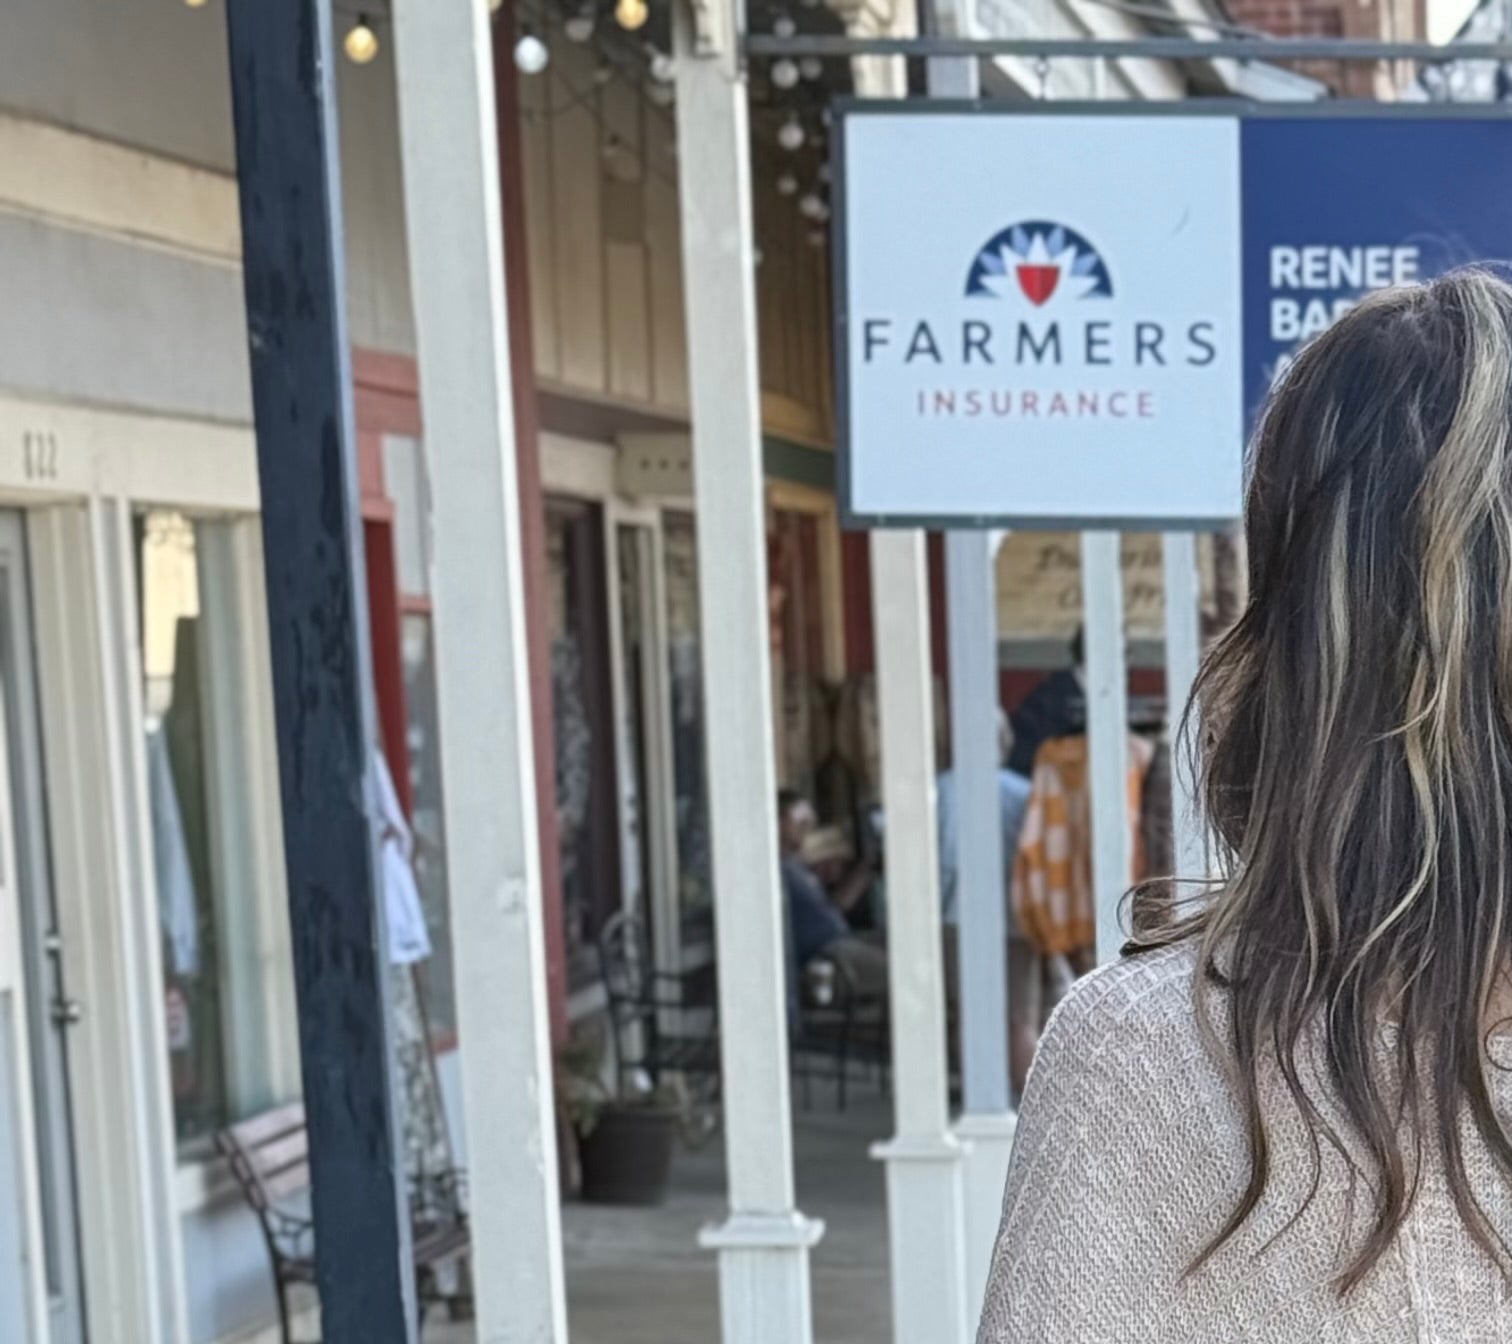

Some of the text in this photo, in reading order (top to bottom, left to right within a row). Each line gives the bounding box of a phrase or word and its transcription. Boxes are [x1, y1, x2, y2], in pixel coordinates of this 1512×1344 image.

[1270, 246, 1420, 289] RENEE
[863, 319, 1217, 367] FARMERS
[917, 390, 1155, 418] INSURANCE
